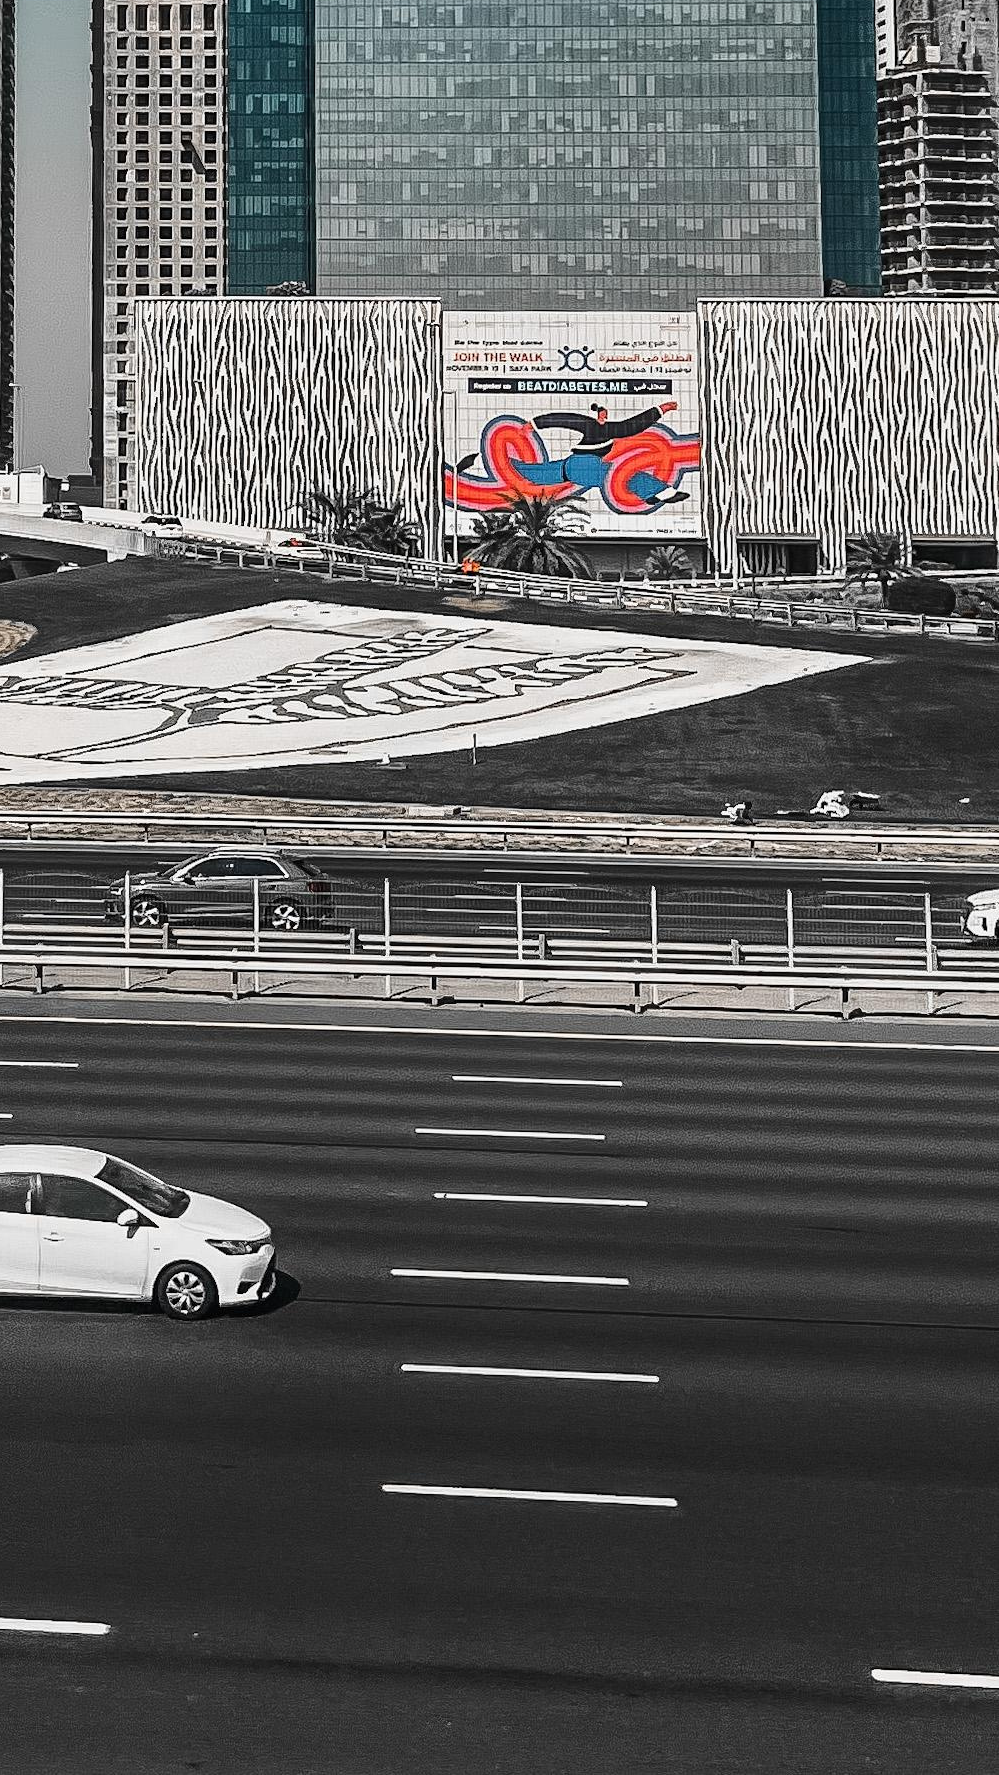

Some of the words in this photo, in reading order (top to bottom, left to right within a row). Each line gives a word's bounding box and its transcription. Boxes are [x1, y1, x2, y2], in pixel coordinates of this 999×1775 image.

[453, 352, 479, 362] JOIN
[484, 352, 507, 362] THE
[509, 352, 543, 362] WALK
[517, 380, 629, 392] BEATDIABETES.ME
